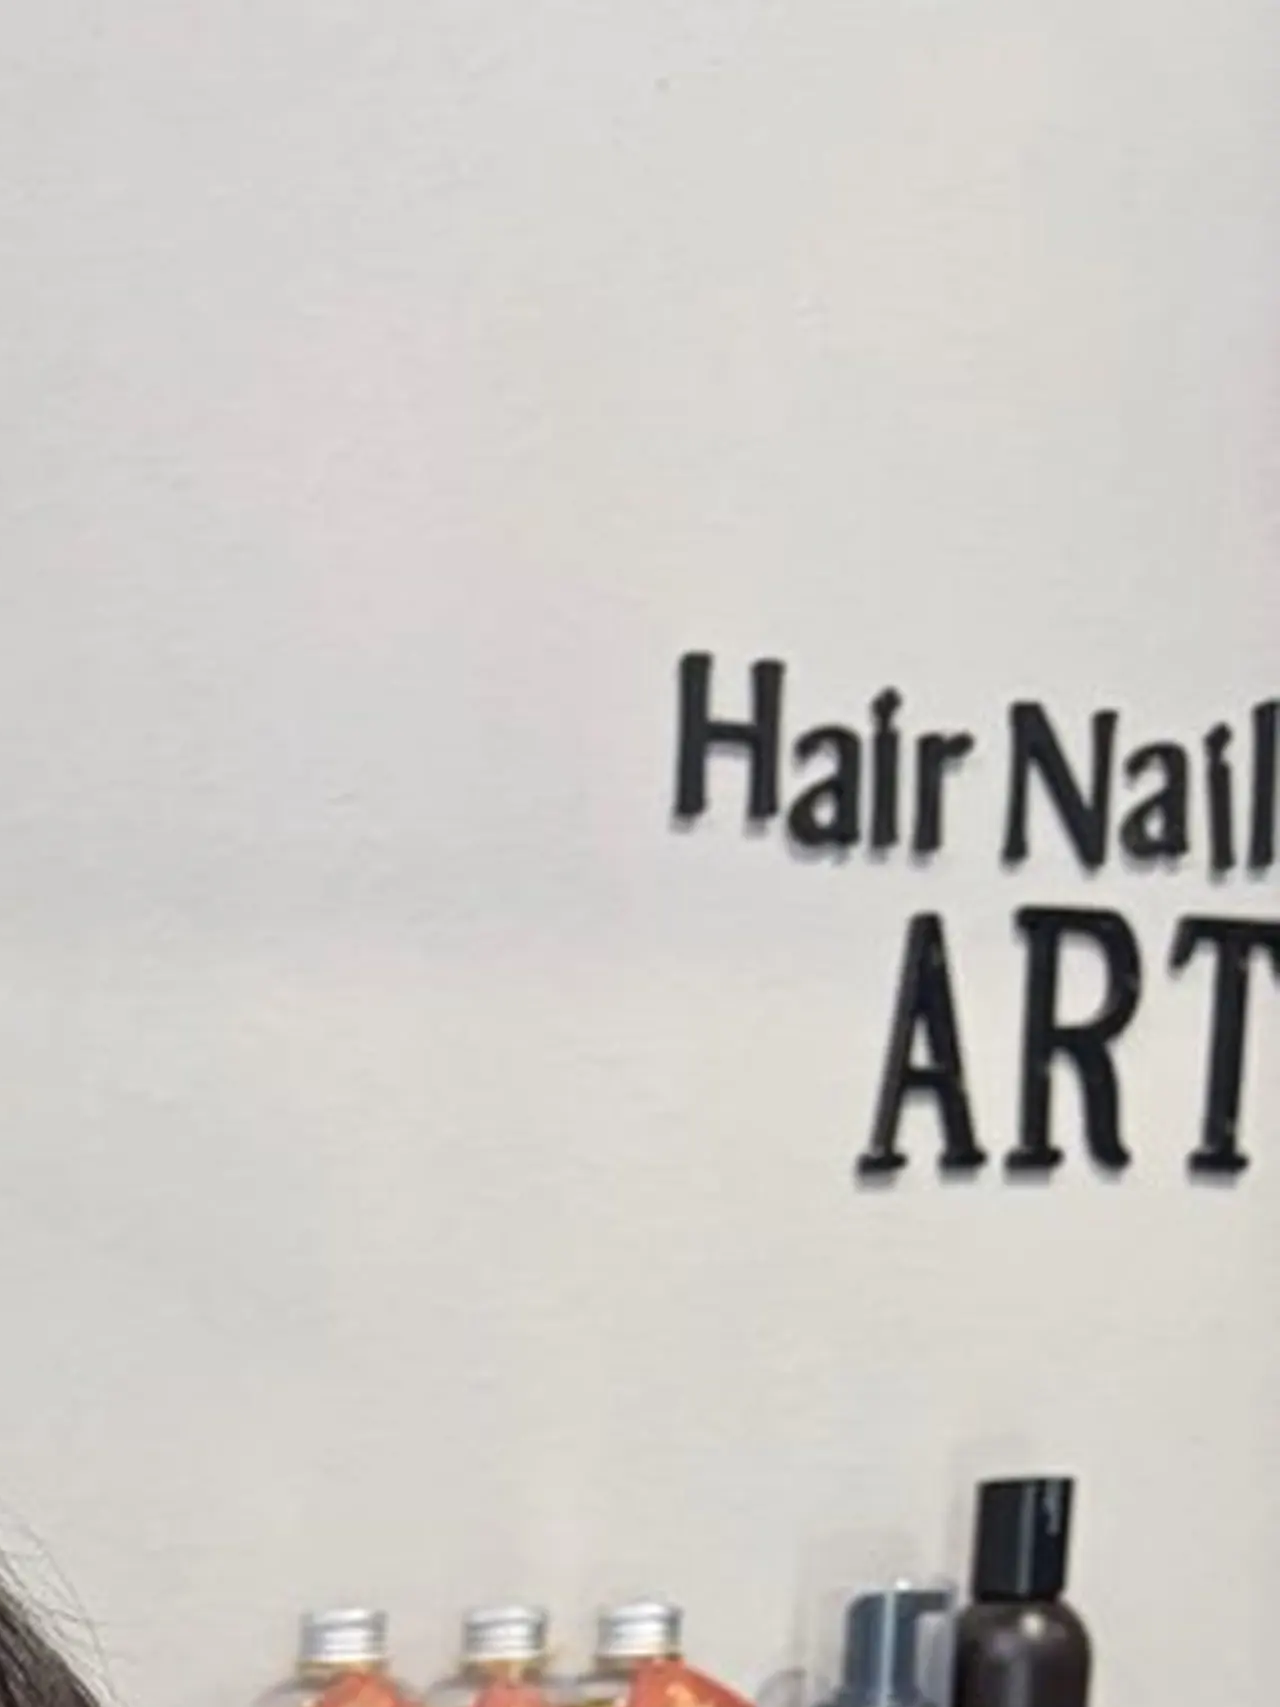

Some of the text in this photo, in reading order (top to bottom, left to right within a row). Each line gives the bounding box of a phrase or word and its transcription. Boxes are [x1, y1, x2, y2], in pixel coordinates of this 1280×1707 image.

[672, 651, 1280, 875] Hair Nail
[856, 905, 1280, 1178] ART
